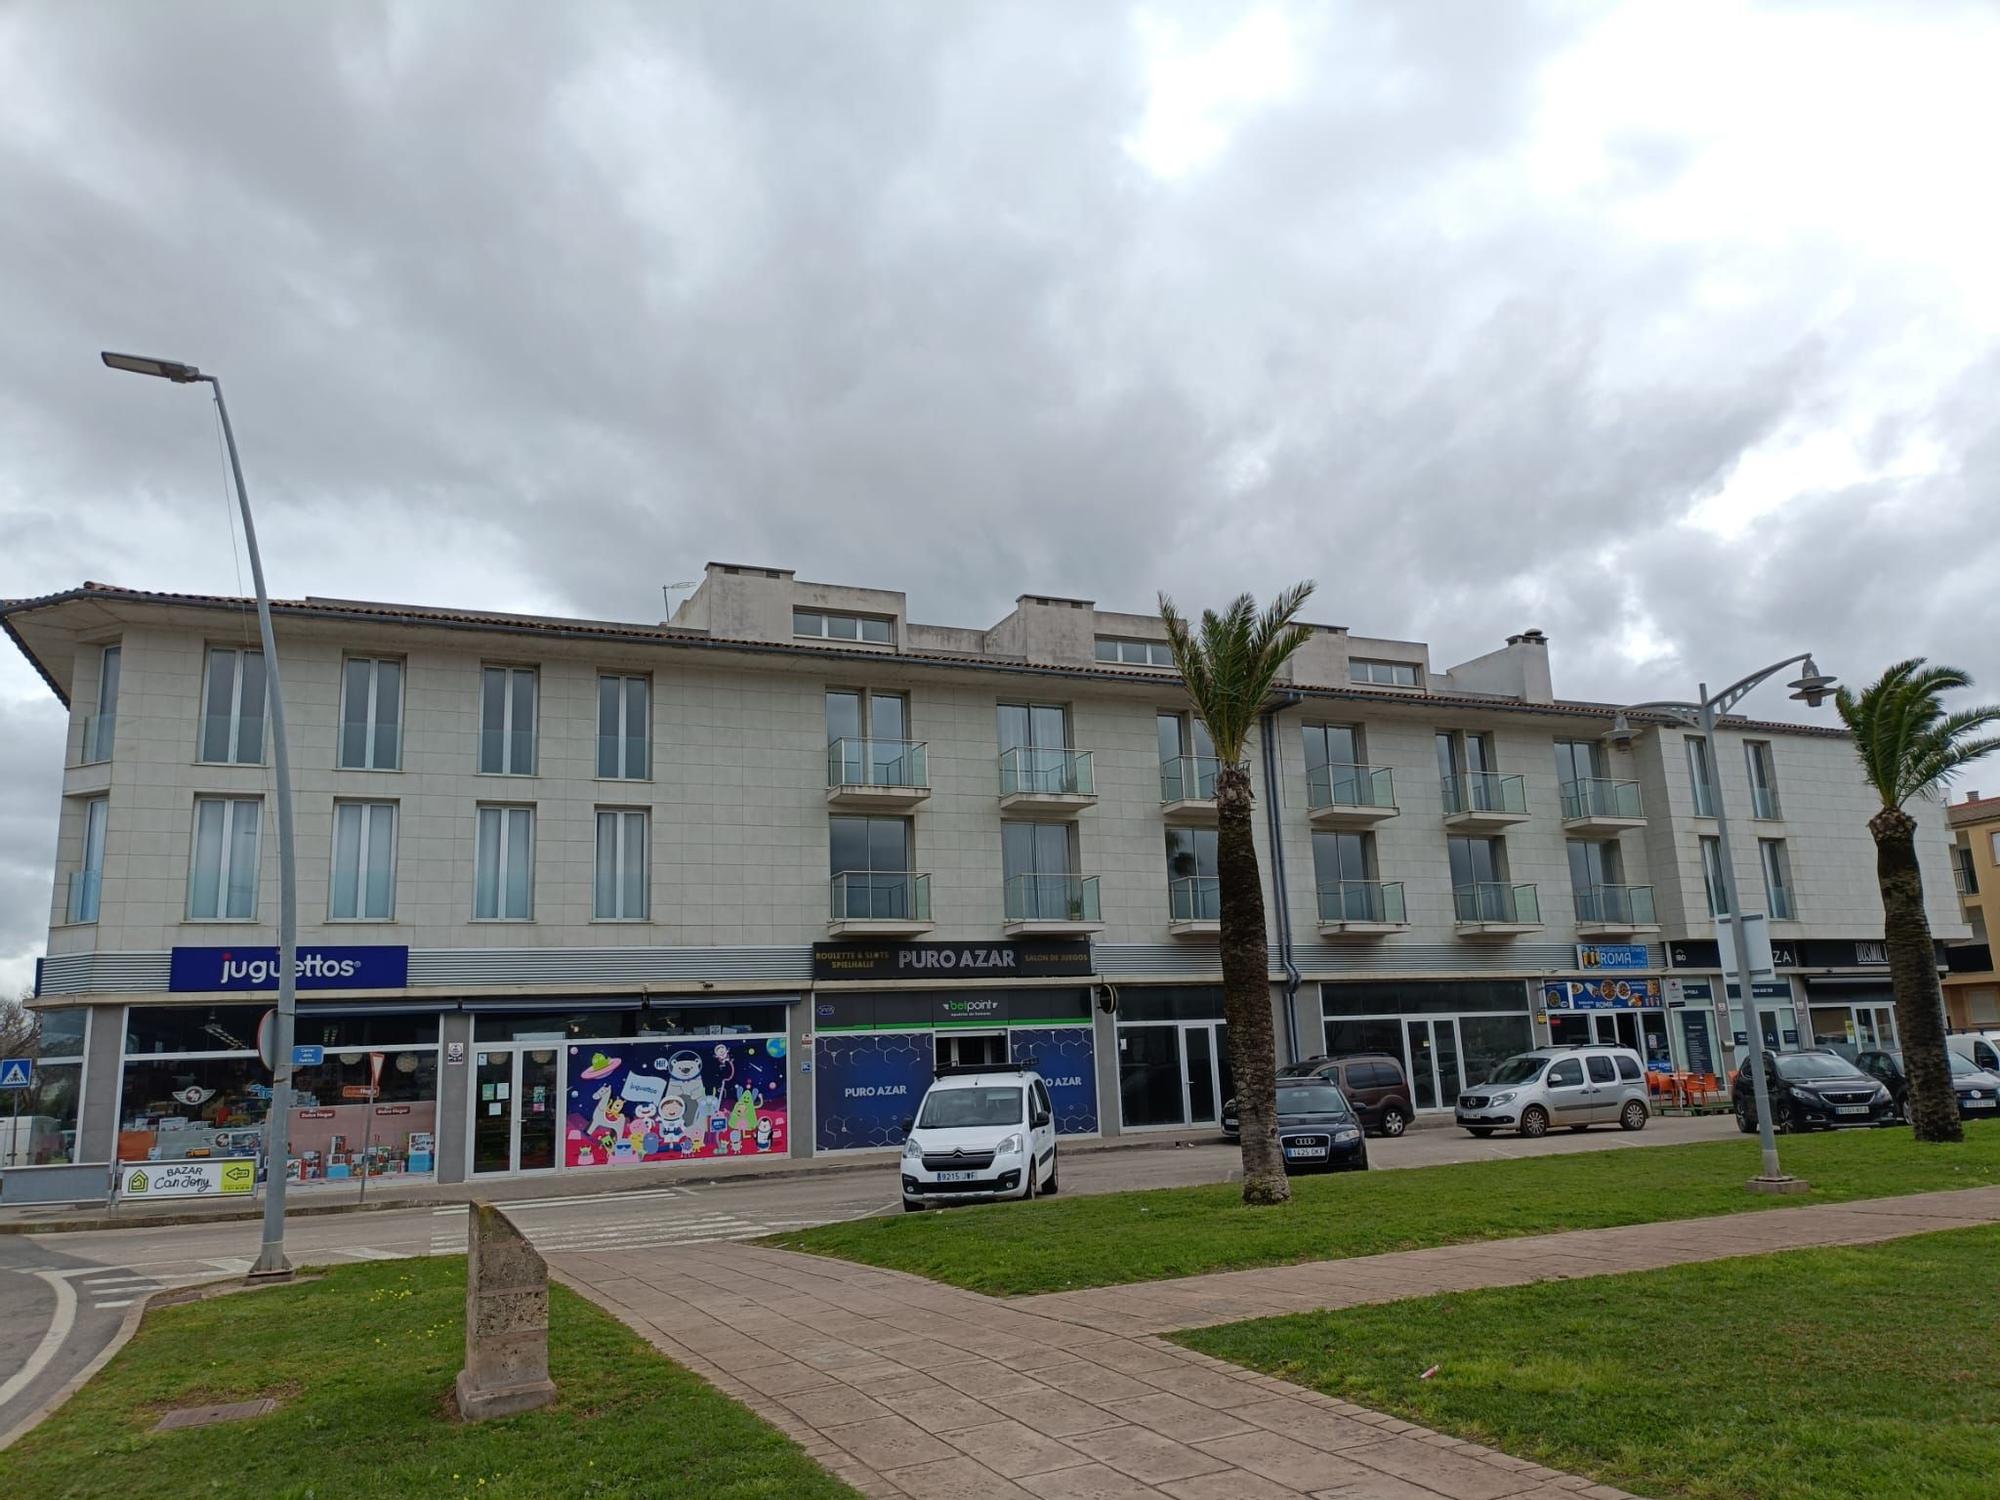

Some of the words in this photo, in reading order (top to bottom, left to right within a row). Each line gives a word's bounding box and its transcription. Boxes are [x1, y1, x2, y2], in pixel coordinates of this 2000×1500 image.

[816, 951, 855, 960] ROULETTE
[899, 949, 955, 969] PURO
[959, 950, 1016, 968] AZAR
[1600, 952, 1631, 965] ROMA
[831, 961, 874, 969] SPIELHALLE
[1054, 1076, 1082, 1086] AZAR
[845, 1087, 876, 1098] PURO
[876, 1085, 907, 1096] AZAR
[166, 1166, 203, 1177] BAZAR
